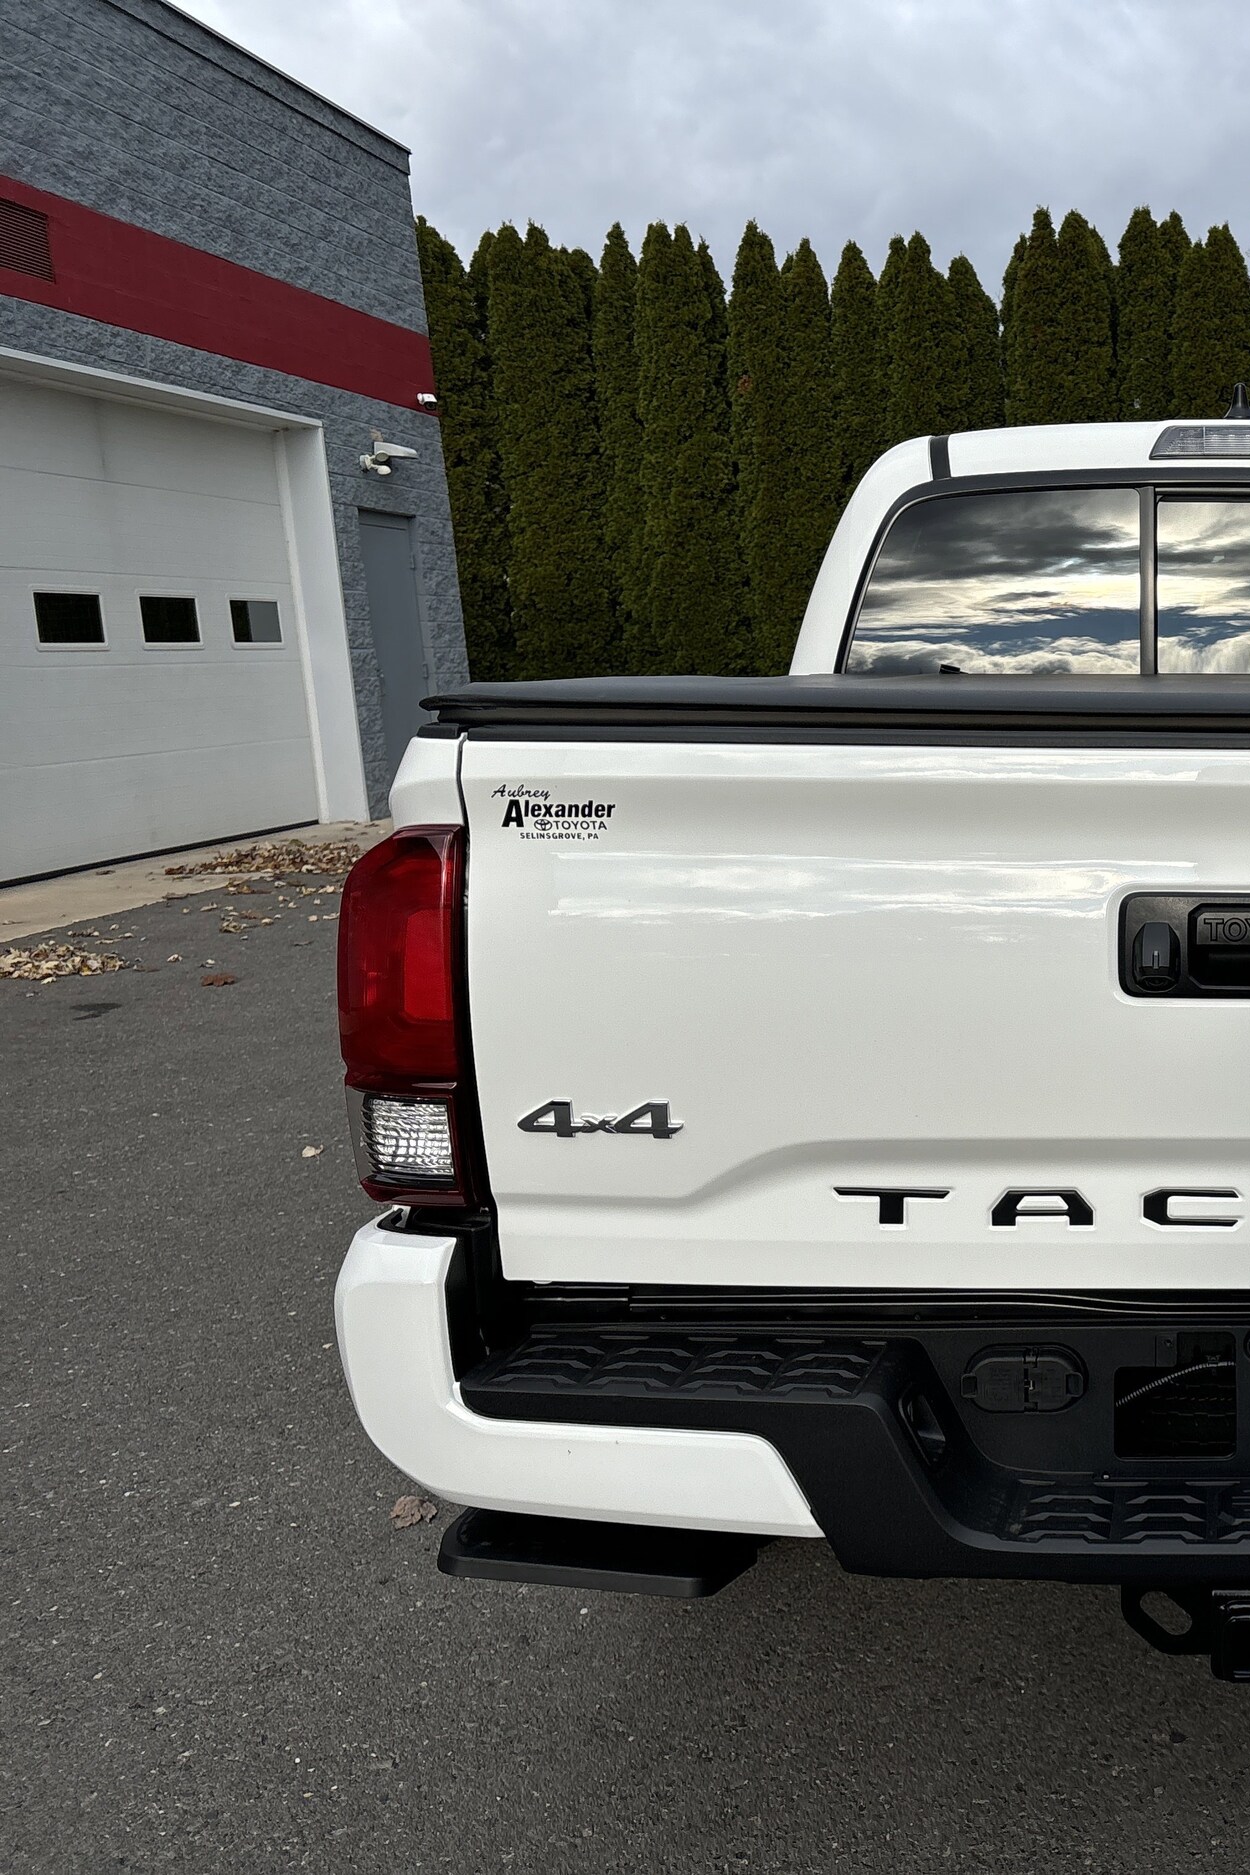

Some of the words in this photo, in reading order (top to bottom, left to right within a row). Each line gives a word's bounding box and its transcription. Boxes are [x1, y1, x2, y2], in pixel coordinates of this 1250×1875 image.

[491, 784, 551, 801] Aubrey
[501, 799, 616, 828] Alexander
[552, 820, 608, 830] TOYOTA
[519, 832, 586, 840] SELINSGROVE,
[587, 832, 599, 840] PA
[516, 1097, 686, 1139] 4x4
